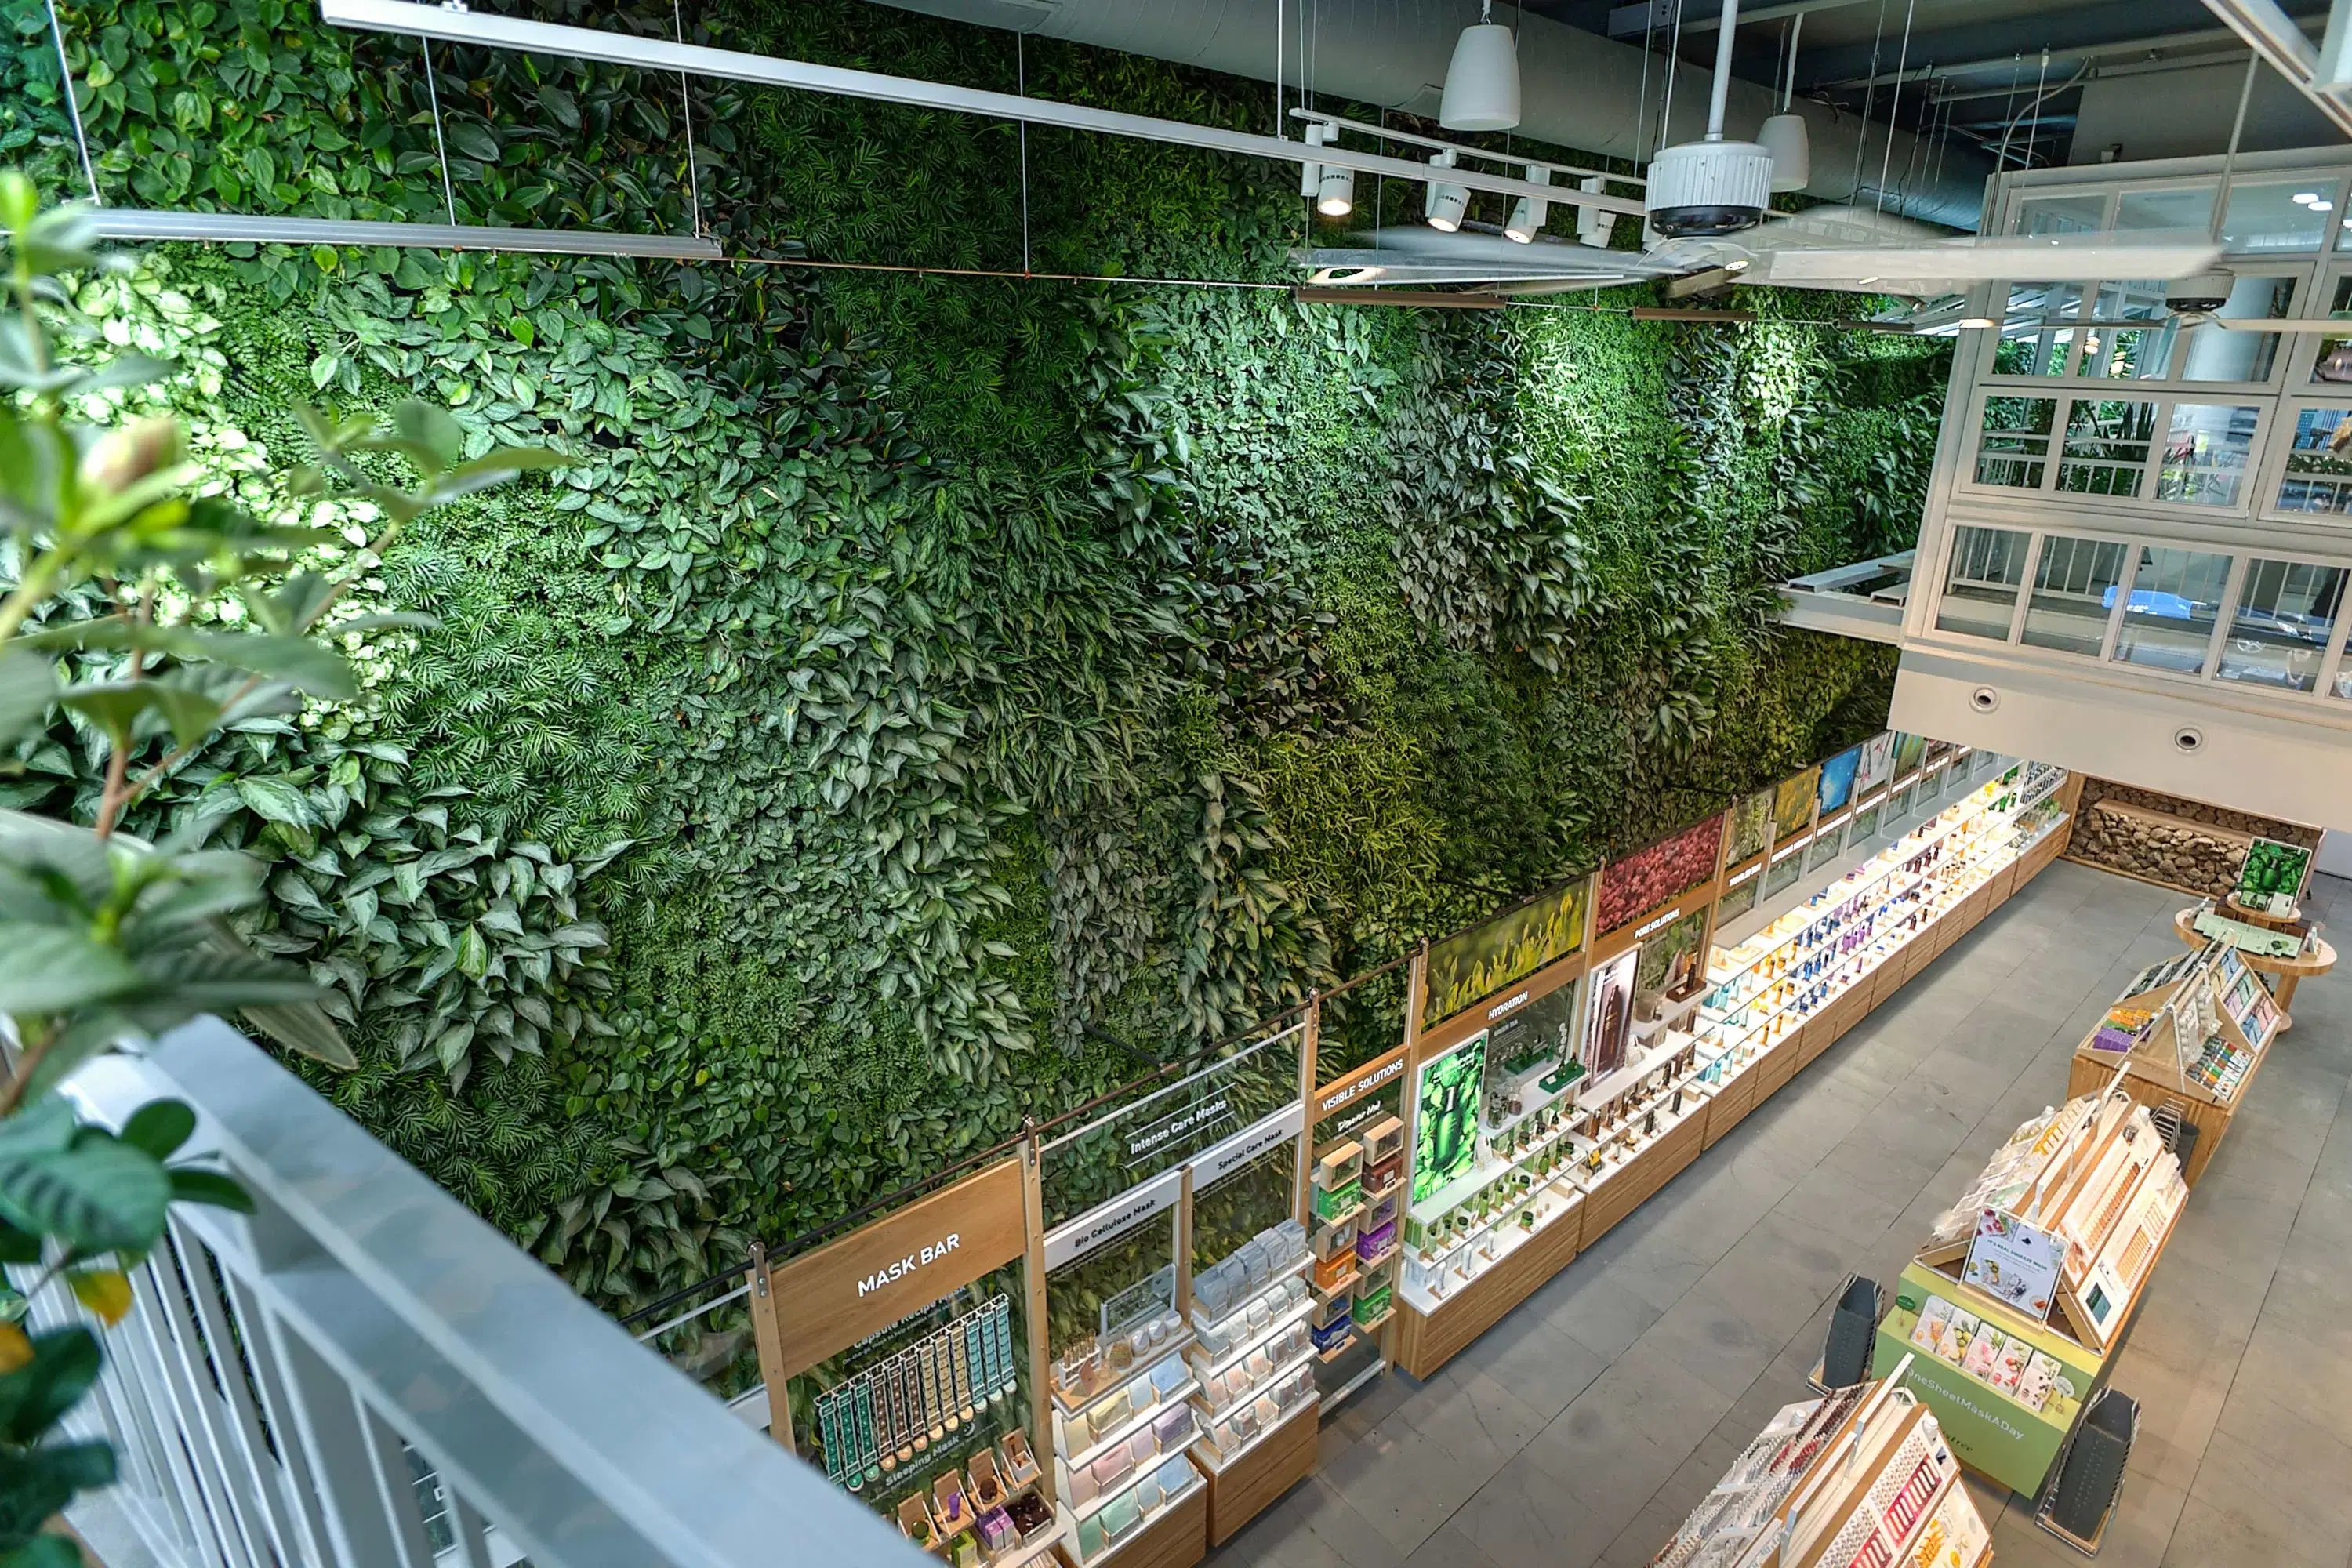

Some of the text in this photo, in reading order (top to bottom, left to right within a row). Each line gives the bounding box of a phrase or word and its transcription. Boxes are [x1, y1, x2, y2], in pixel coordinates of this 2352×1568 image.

[1488, 991, 1528, 1020] HYDRATION
[1322, 1085, 1356, 1111] VISIBLE
[1358, 1058, 1403, 1092] SOLUTIONS
[1131, 1100, 1227, 1155] Intense Care Masks
[1218, 1130, 1283, 1170] Special Care Mask
[1074, 1199, 1156, 1248] Bio Cellulose Mask
[857, 1233, 960, 1297] MASK BAR
[885, 1435, 960, 1486] Sleeping Mask
